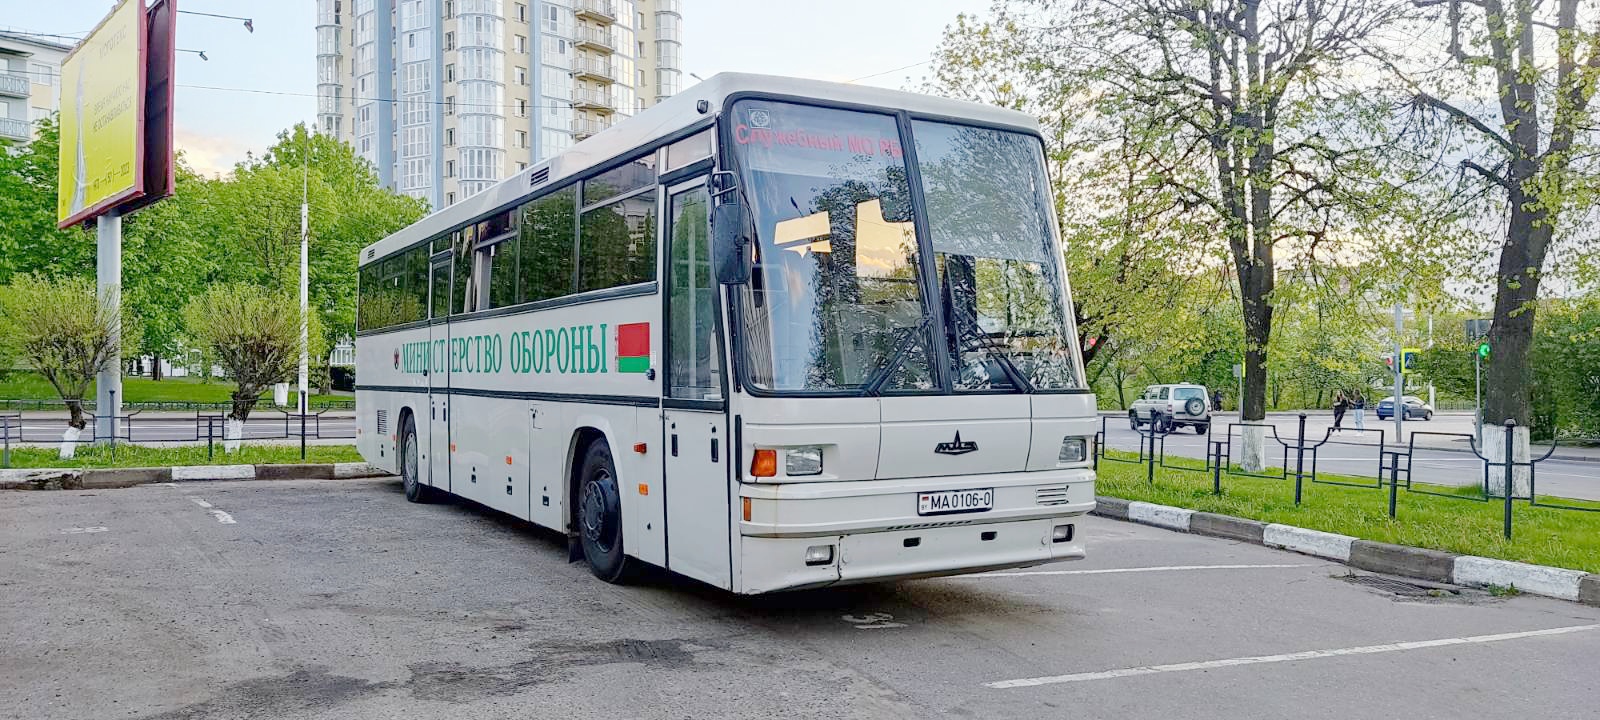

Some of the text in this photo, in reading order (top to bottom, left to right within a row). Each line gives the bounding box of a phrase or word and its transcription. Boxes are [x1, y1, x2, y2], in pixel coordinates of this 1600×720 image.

[735, 123, 843, 150] Служебный
[847, 134, 875, 156] МО
[401, 323, 608, 374] МИНИСТЕРСТВО ОБОРОНЫ
